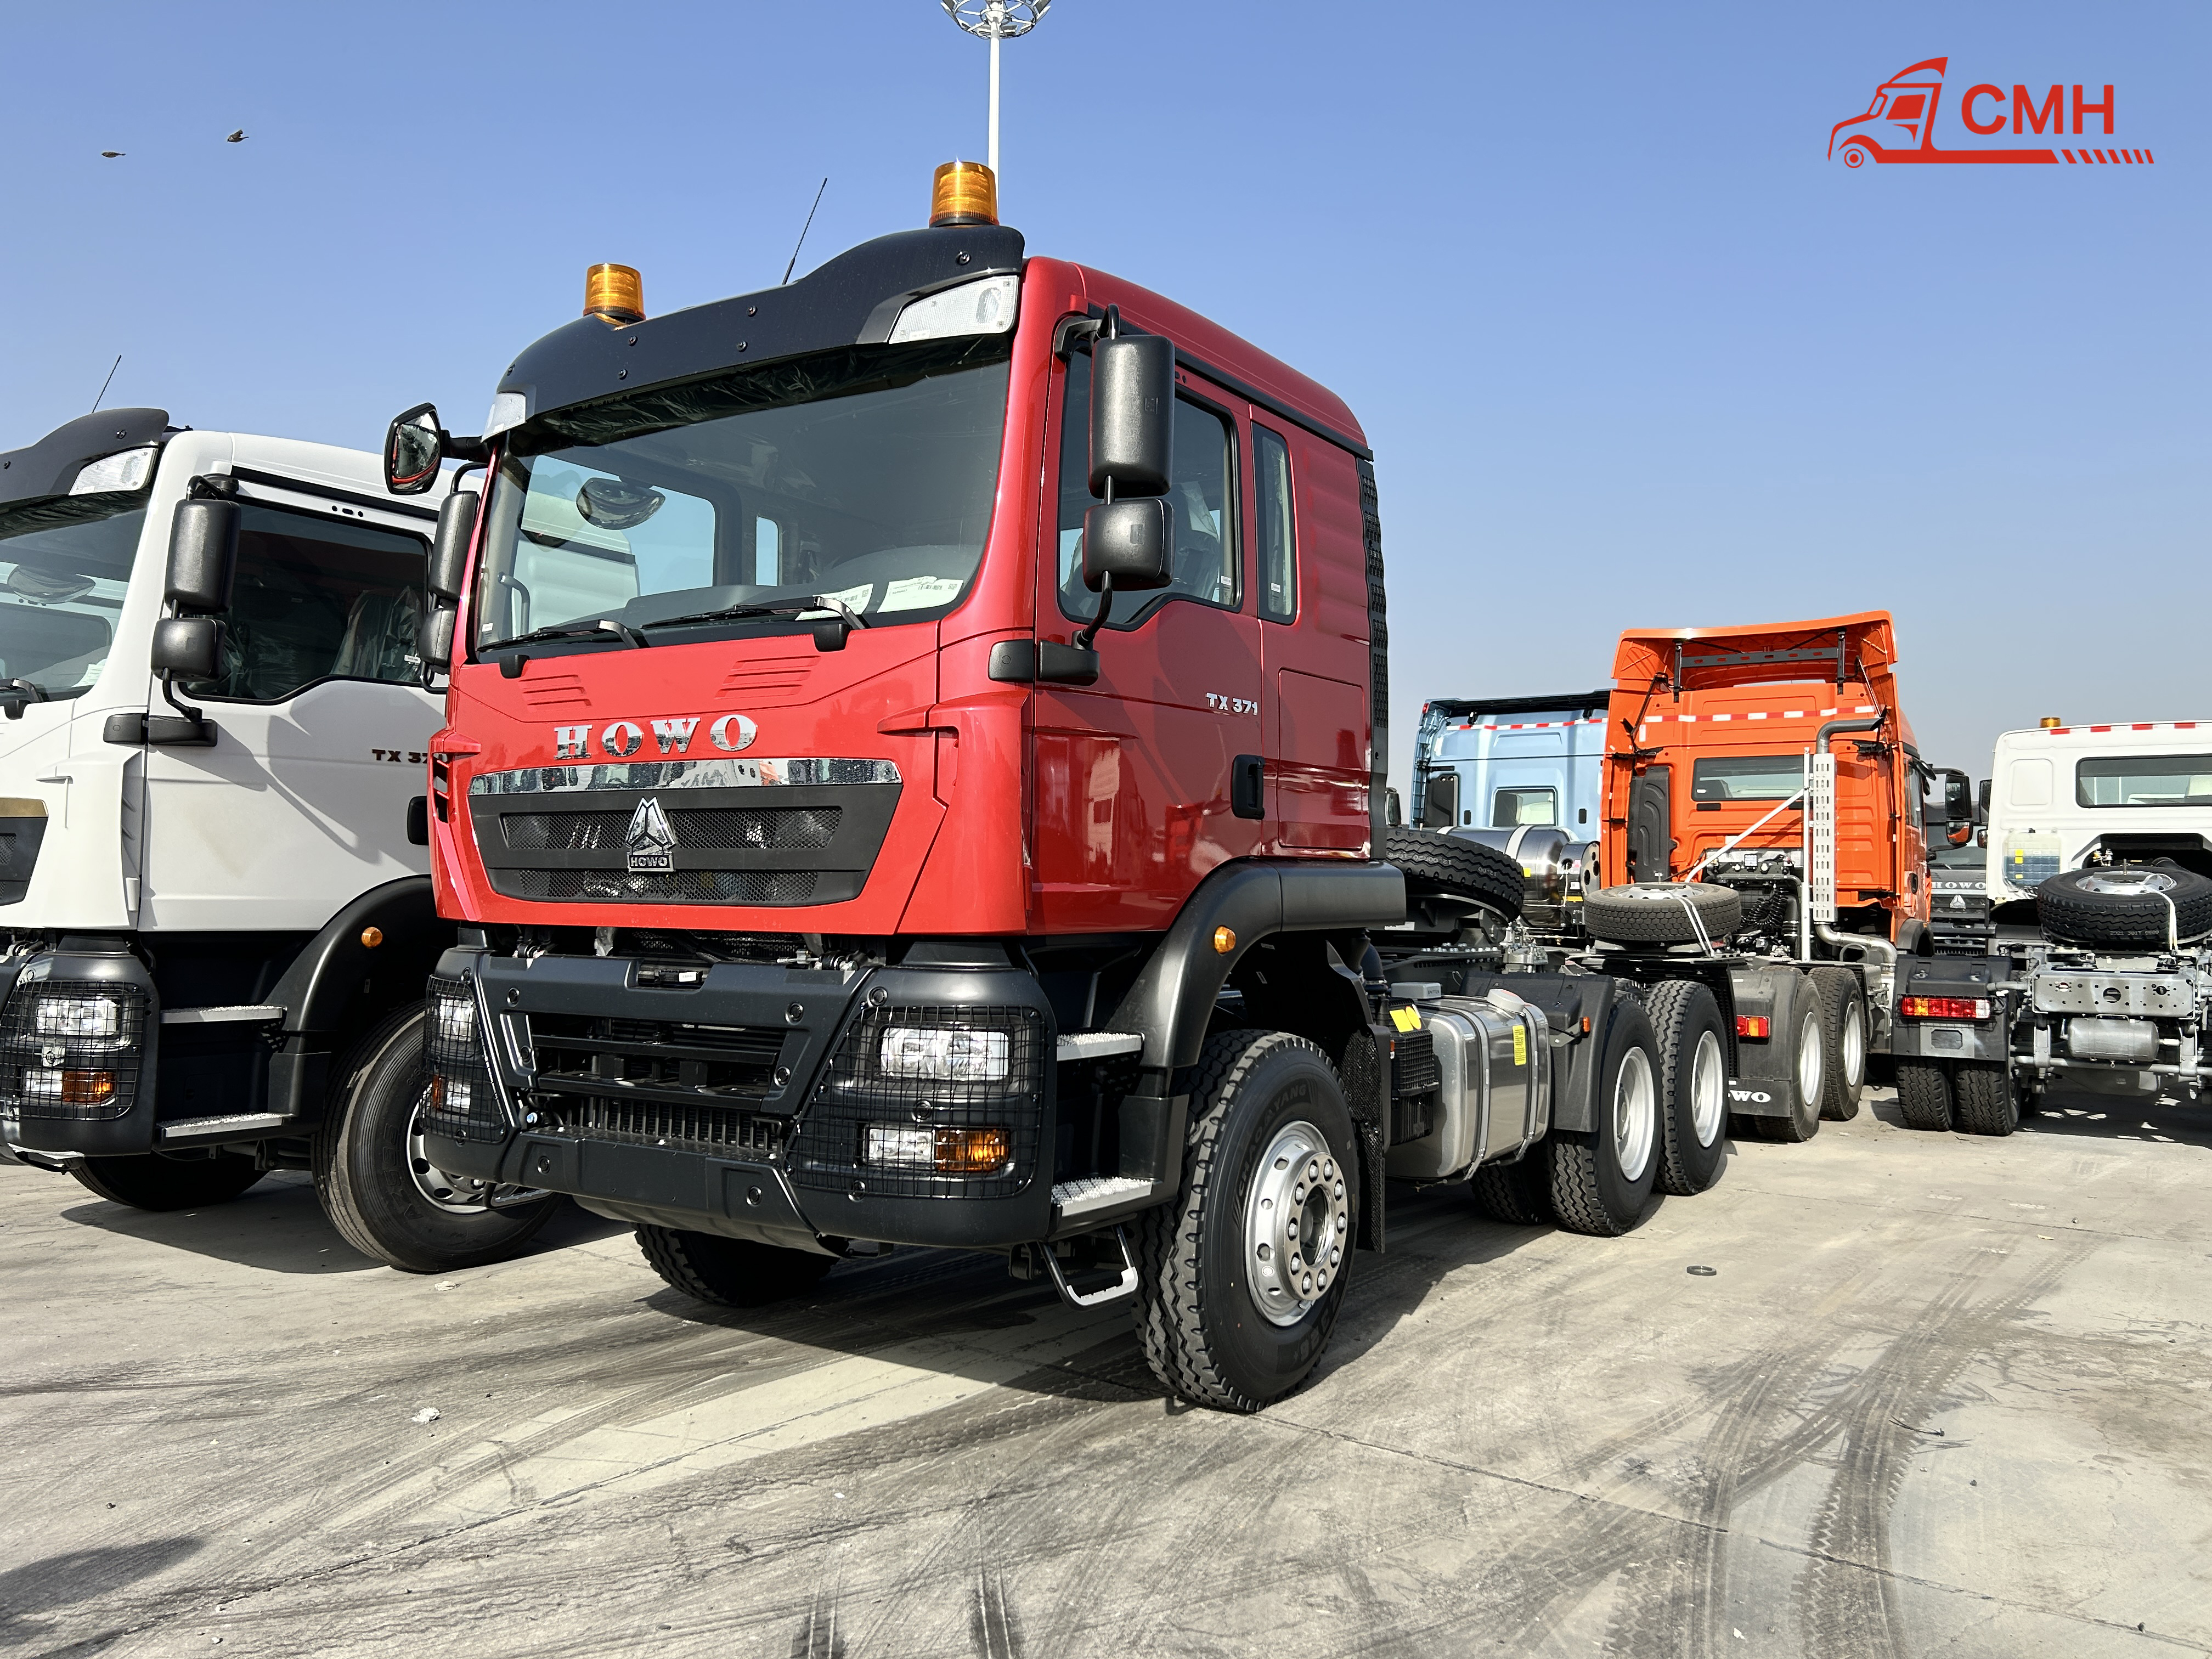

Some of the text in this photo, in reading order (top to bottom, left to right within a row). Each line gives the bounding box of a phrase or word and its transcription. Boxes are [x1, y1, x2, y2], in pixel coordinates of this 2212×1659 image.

[1206, 692, 1258, 715] TX 371
[554, 714, 758, 760] HOWO
[371, 749, 401, 763] TX
[631, 856, 668, 867] HOWO
[1728, 1090, 1771, 1103] WO
